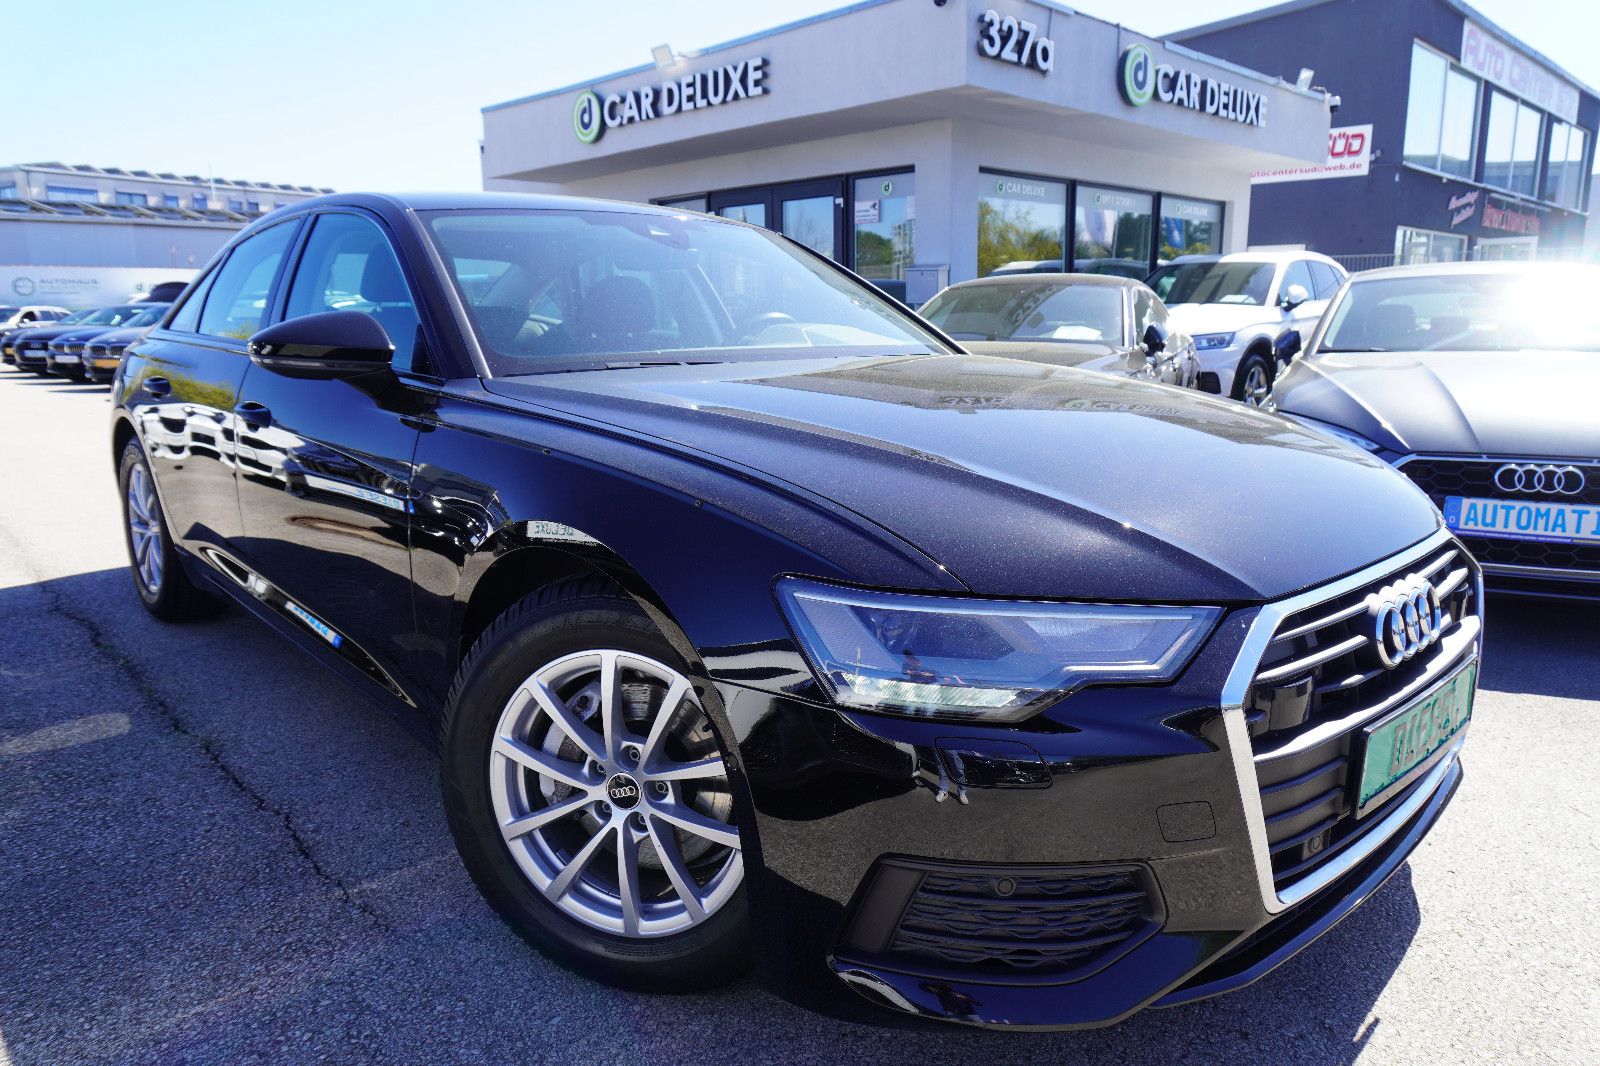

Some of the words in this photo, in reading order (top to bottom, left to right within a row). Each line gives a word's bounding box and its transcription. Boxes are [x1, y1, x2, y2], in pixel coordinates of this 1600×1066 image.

[979, 9, 1054, 74] 327a
[603, 86, 655, 128] CAR
[662, 57, 768, 116] DELUXE
[1156, 63, 1201, 109] CAR
[1205, 77, 1268, 128] DELUXE
[1328, 131, 1366, 158] ÜD
[1007, 182, 1020, 195] CAR
[1022, 184, 1046, 197] DELUXE
[1389, 679, 1460, 777] DIESEL
